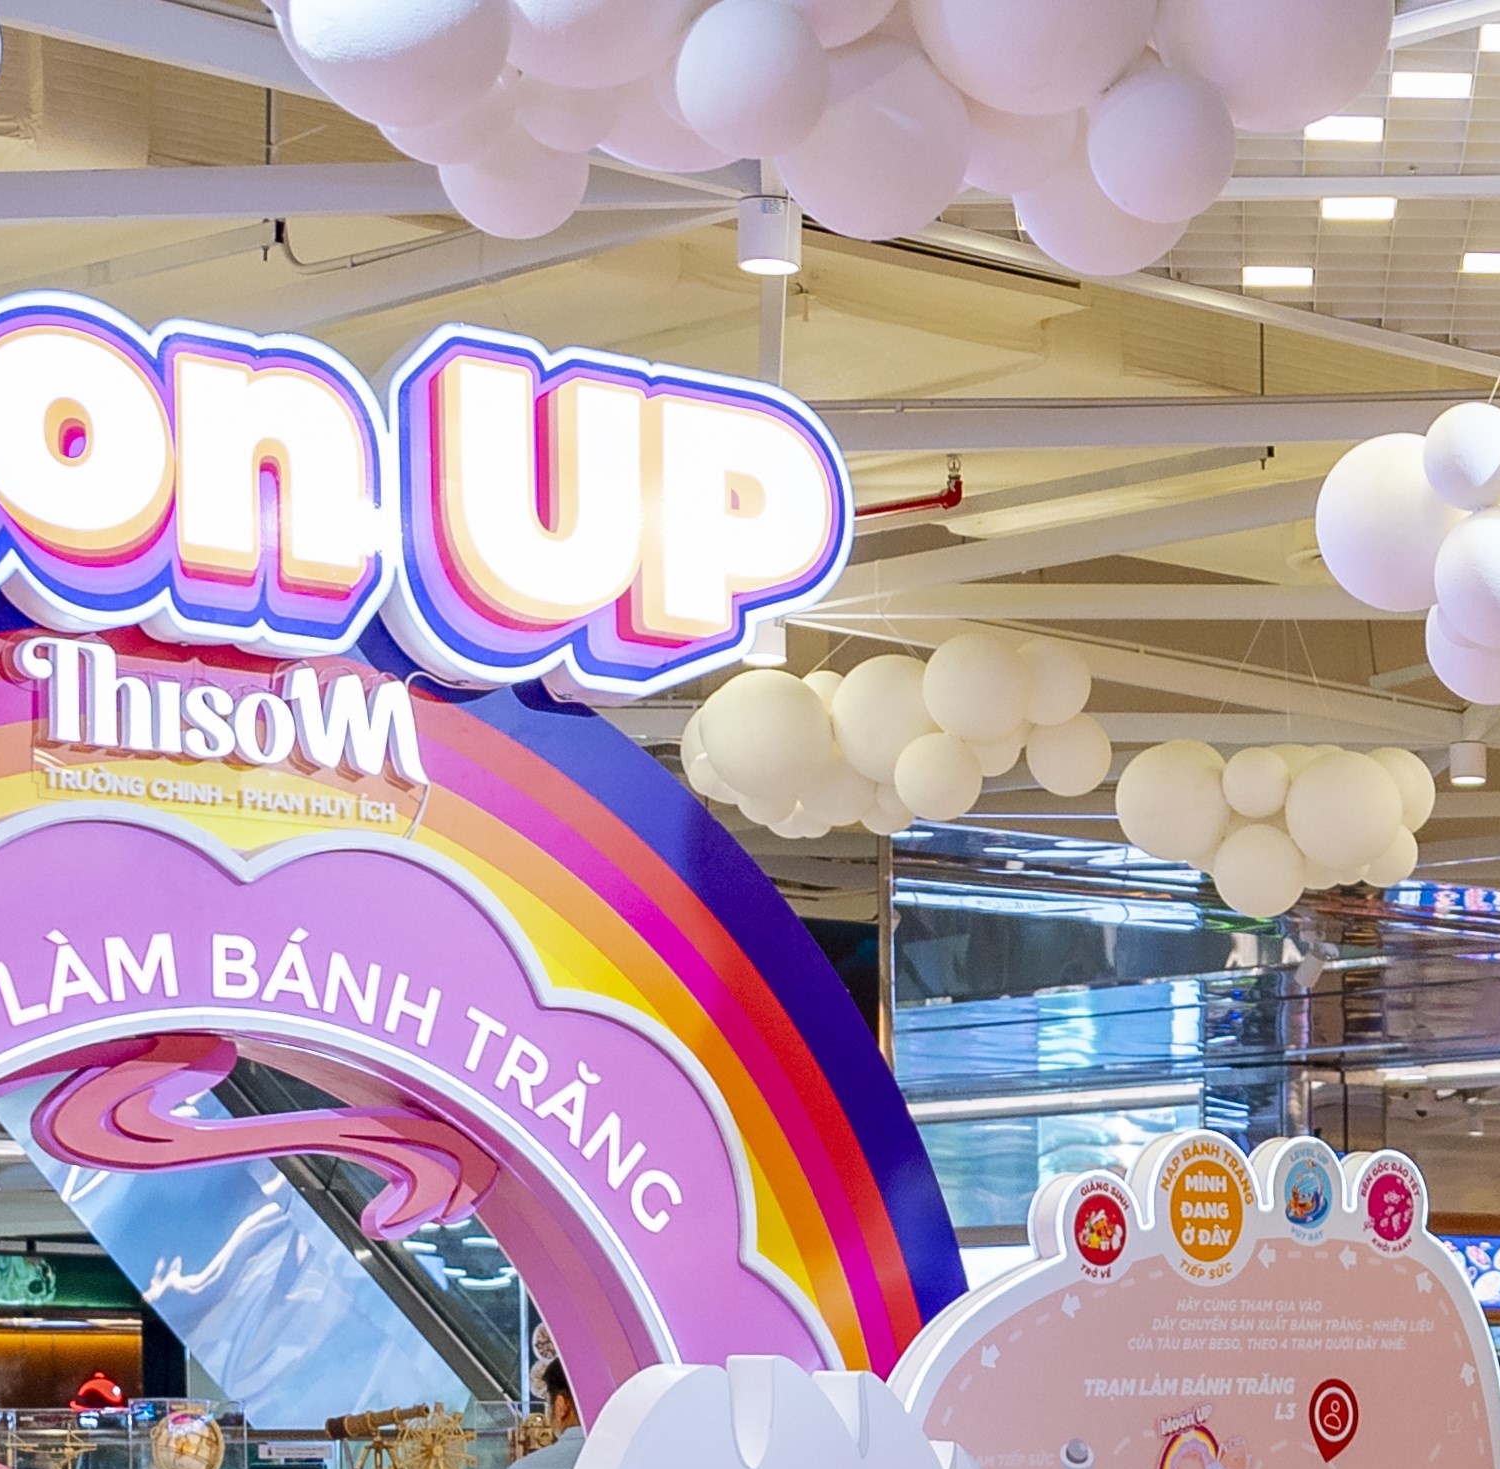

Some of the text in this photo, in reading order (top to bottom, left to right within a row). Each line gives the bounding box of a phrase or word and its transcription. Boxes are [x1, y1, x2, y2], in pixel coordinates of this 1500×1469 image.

[455, 348, 832, 632] UP
[45, 765, 146, 797] TRƯỜNG
[243, 789, 304, 813] PHAN
[310, 796, 354, 821] HUY
[358, 791, 396, 822] ÍCH
[5, 929, 181, 1026] LÀM
[209, 929, 442, 1041] BÁNH
[465, 1004, 683, 1235] TRĂNG
[1160, 1157, 1180, 1192] NẠP
[1182, 1140, 1221, 1162] BÁNH
[1372, 1161, 1390, 1177] GỐC
[1185, 1169, 1228, 1193] MÌNH
[1080, 1180, 1131, 1211] GIÁNG SINH
[1180, 1201, 1229, 1220] ĐANG
[1181, 1221, 1233, 1246] Ở ĐÂY
[1179, 1259, 1233, 1279] TIẾP SỨC
[1176, 1296, 1323, 1312] HÃY CÙNG THAM GIA VÀO
[1256, 1314, 1287, 1331] XUẤT
[1290, 1316, 1323, 1332] BÁNH
[1373, 1317, 1407, 1332] NHIÊN
[1409, 1317, 1435, 1334] LIỆU
[1128, 1333, 1153, 1350] CỦA
[1156, 1334, 1181, 1351] TÀU
[1183, 1337, 1206, 1351] BAY
[1208, 1338, 1243, 1352] BESO,
[1247, 1338, 1278, 1351] THEO
[1280, 1338, 1288, 1350] 4
[1291, 1338, 1322, 1353] TRẠM
[1325, 1335, 1354, 1351] DƯỚI
[1356, 1335, 1378, 1351] ĐÂY
[1083, 1372, 1296, 1401] TRẠM LÀM BÁNH TRĂNG
[1159, 1411, 1195, 1436] Moon
[1273, 1402, 1297, 1421] L3
